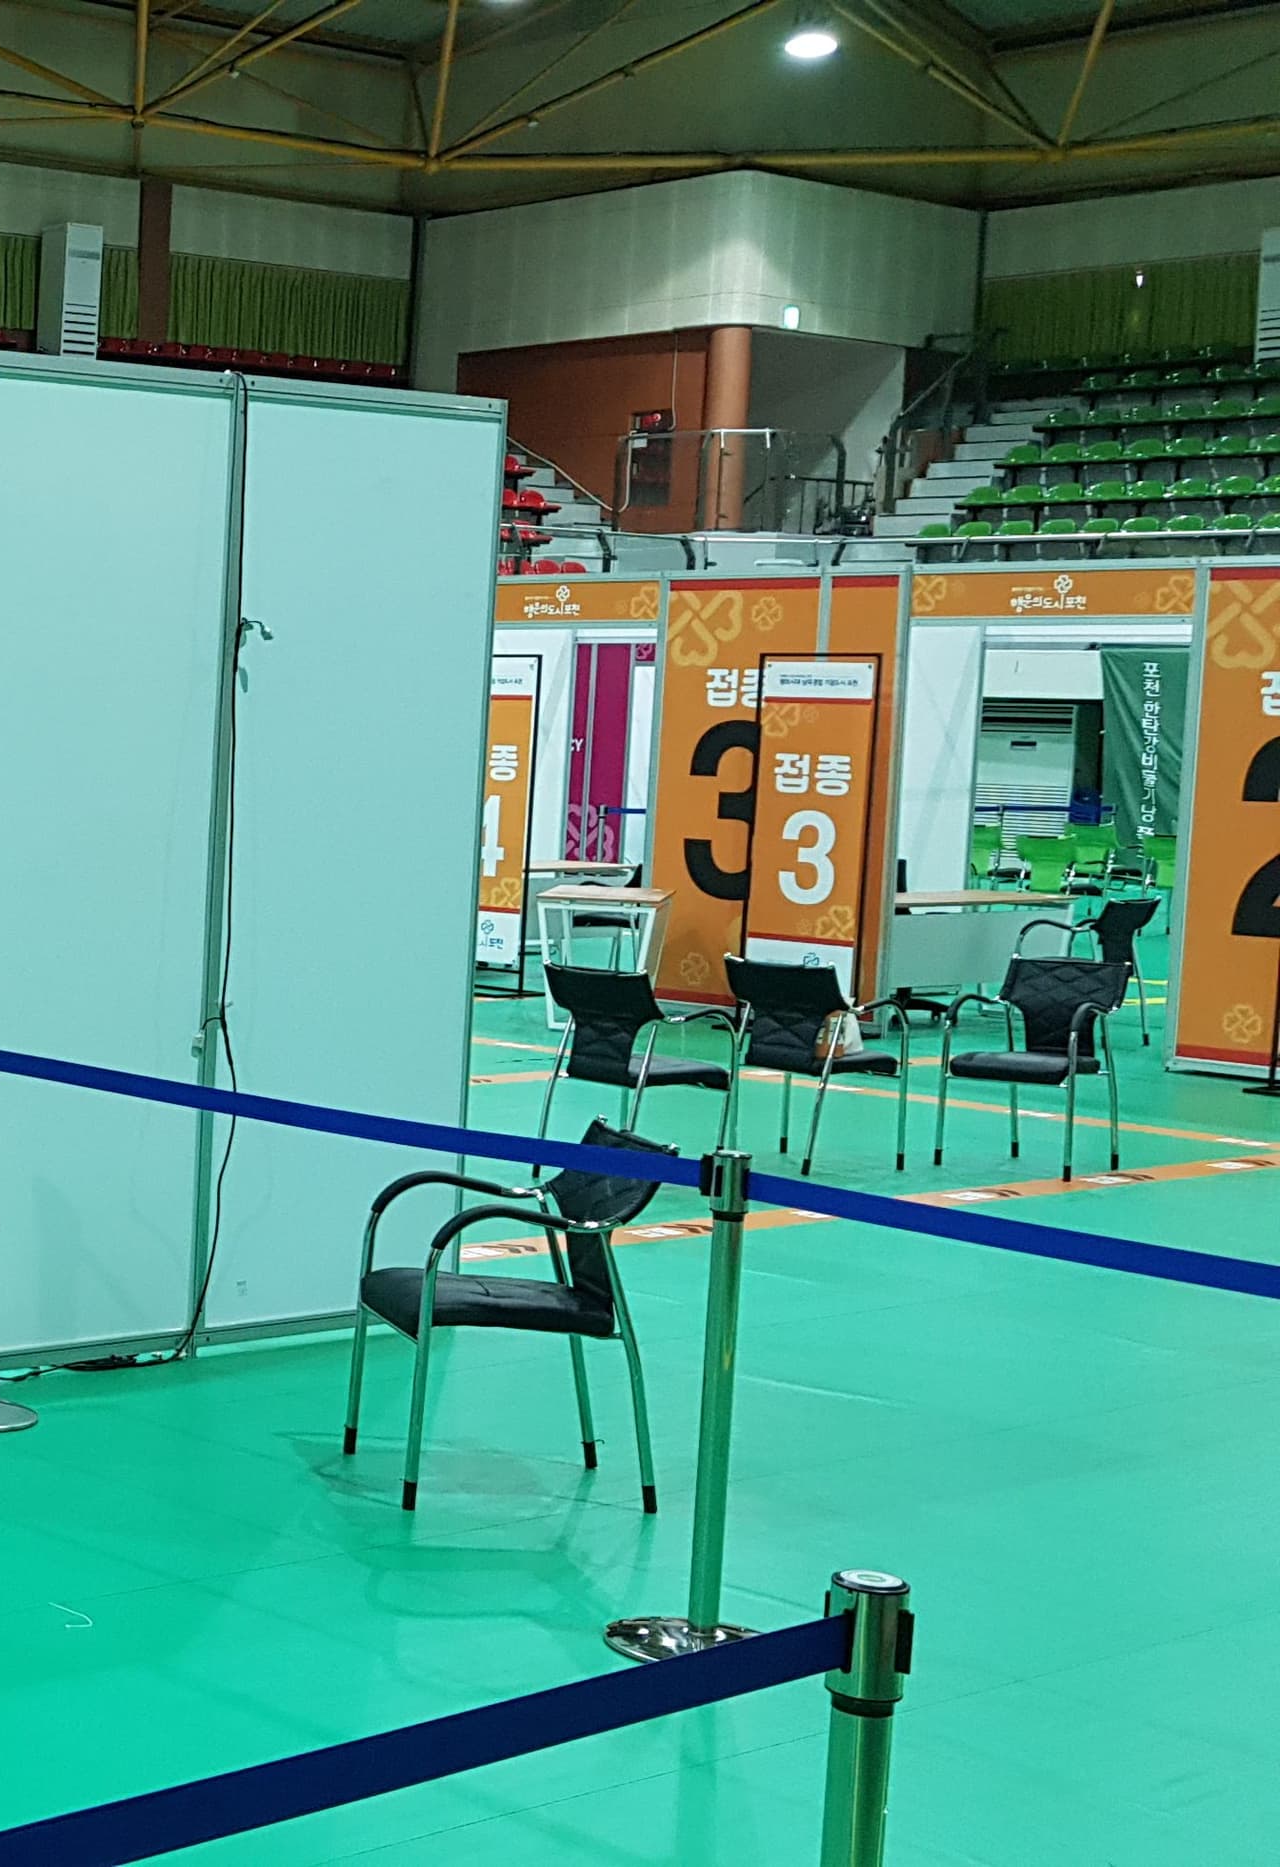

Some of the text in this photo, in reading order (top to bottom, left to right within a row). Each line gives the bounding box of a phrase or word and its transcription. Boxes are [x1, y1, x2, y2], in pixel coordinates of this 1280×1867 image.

[489, 744, 519, 782] 종
[774, 752, 852, 796] 접종
[684, 720, 761, 901] 3
[778, 809, 837, 906] 3
